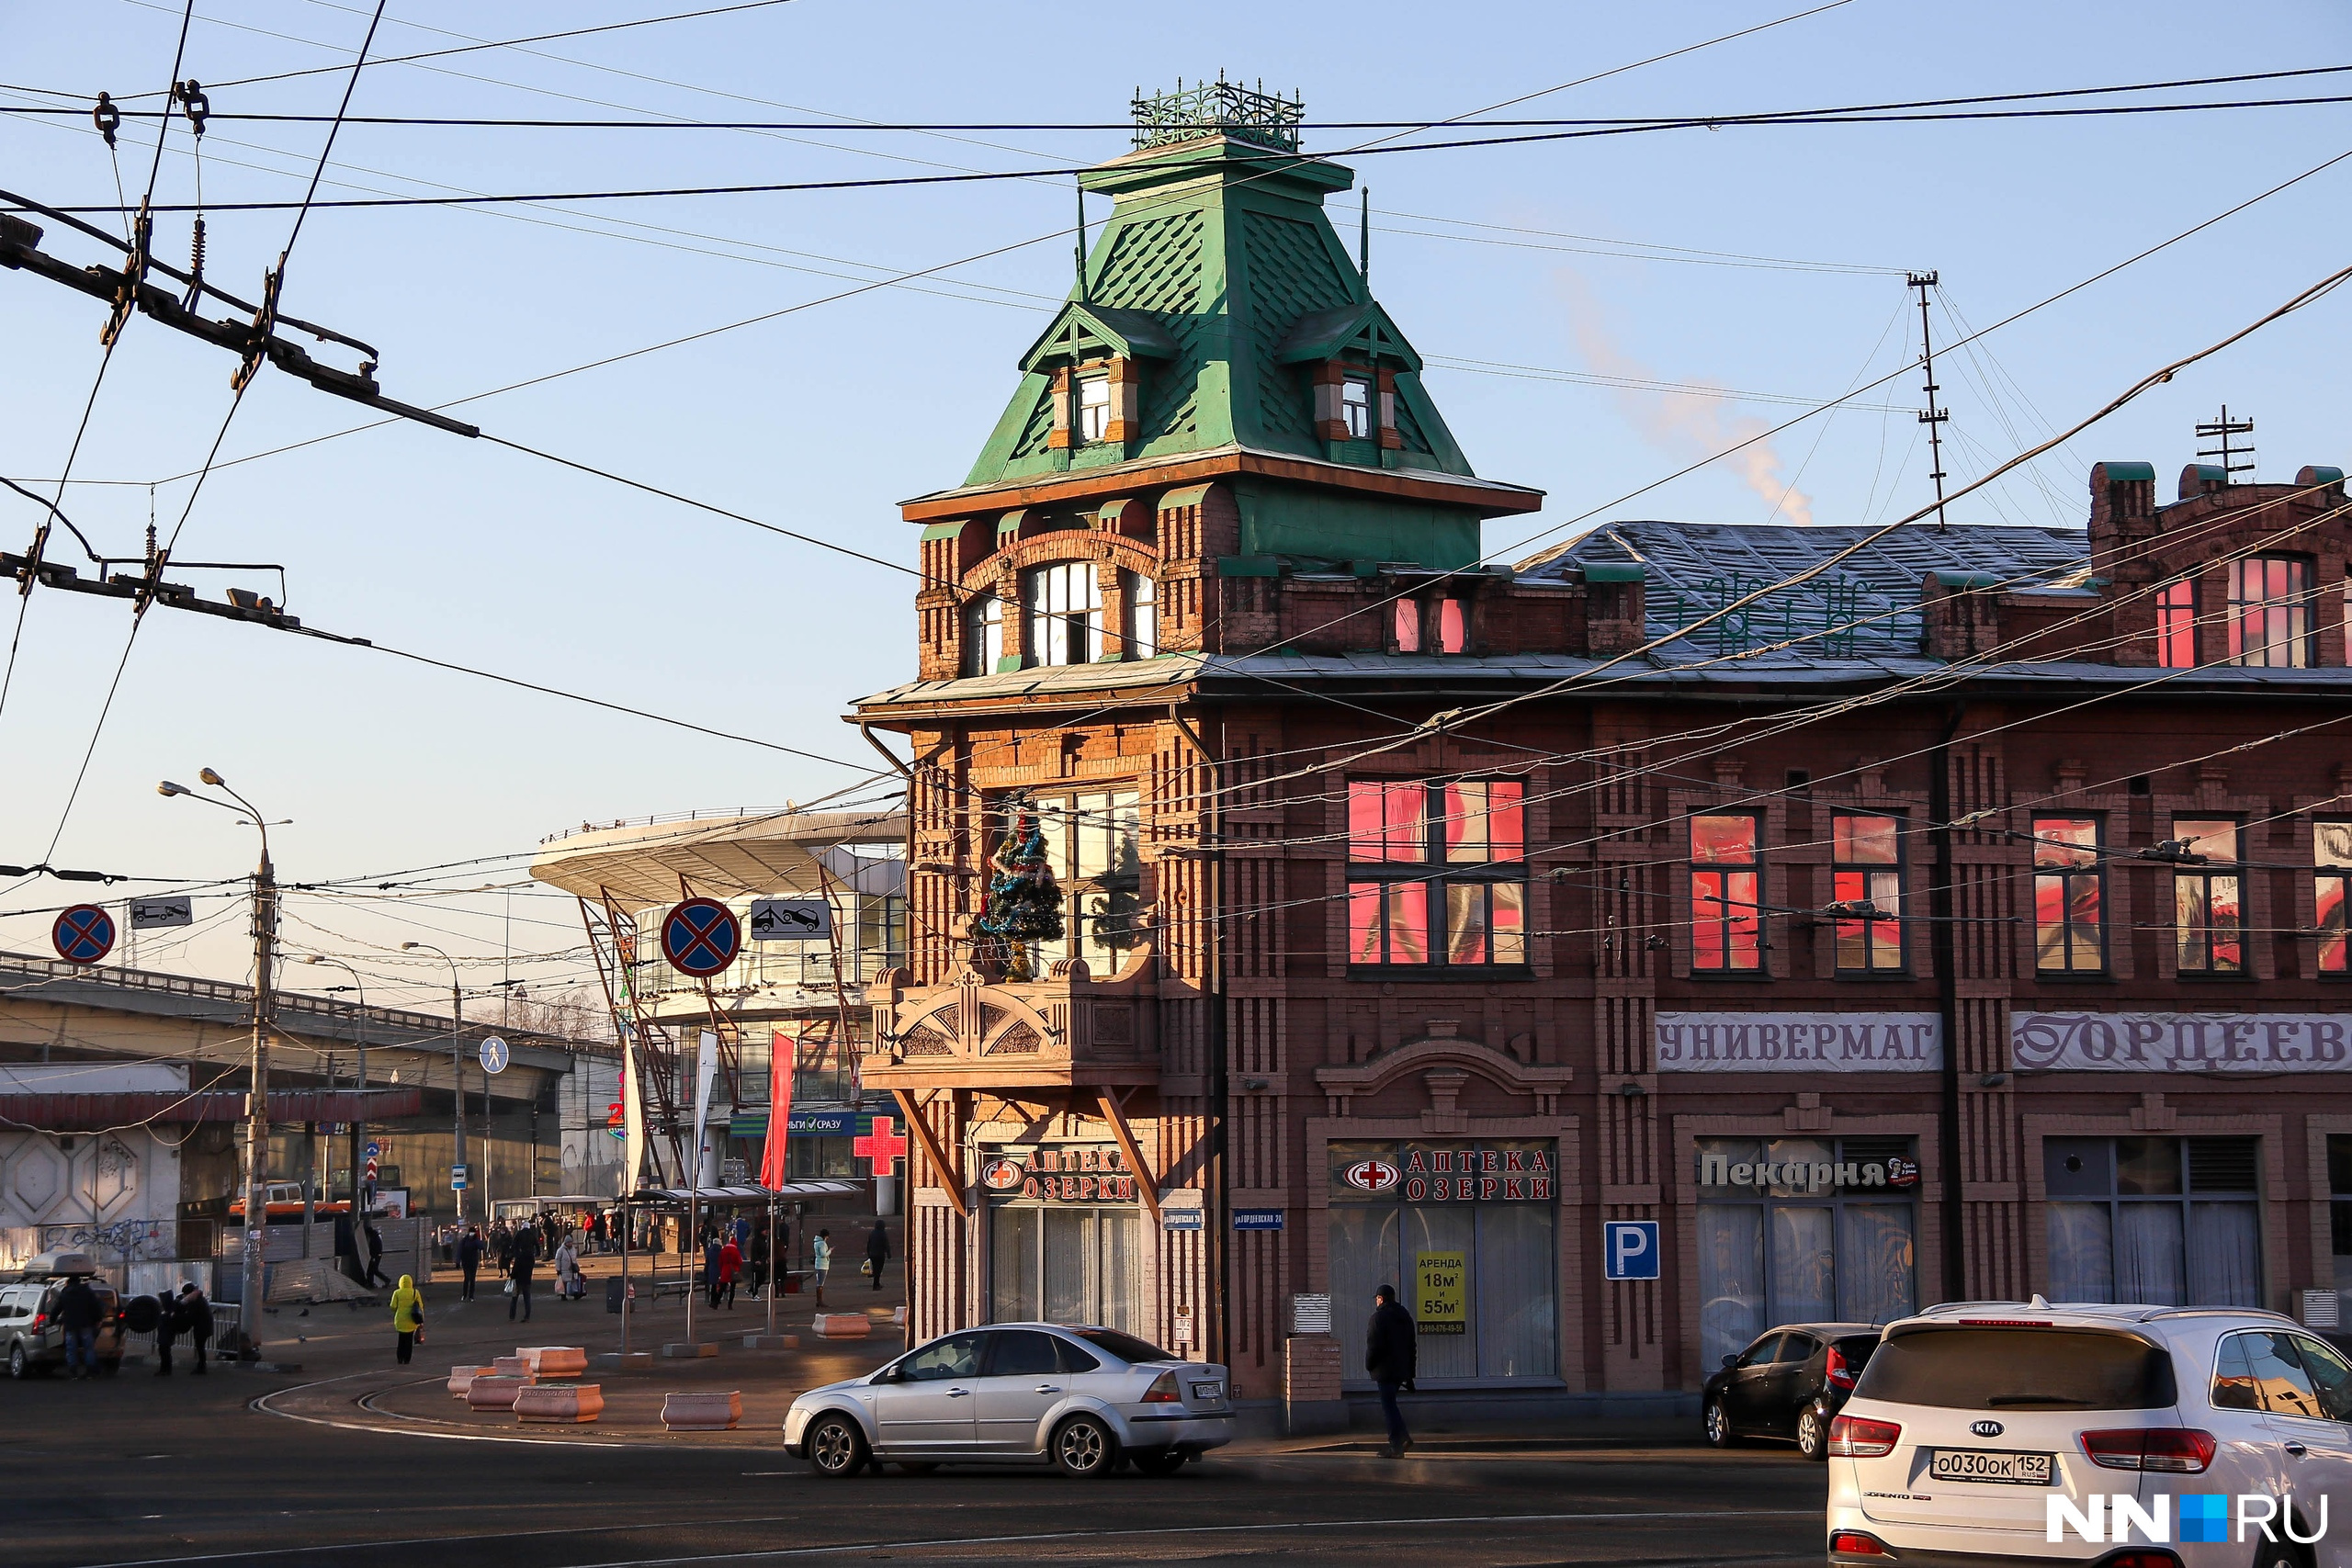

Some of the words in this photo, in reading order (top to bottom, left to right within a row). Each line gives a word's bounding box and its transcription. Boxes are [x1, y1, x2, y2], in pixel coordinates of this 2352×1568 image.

[1656, 1023, 1933, 1061] УНИВЕРМАГ
[2012, 1015, 2352, 1070] ГОРДЕЕВ
[786, 1120, 805, 1129] НЬГИ
[817, 1120, 841, 1129] СРАЗУ
[1024, 1150, 1132, 1172] АПТЕКА
[1408, 1150, 1550, 1172] АПТЕКА
[1701, 1155, 1886, 1193] Пекарня
[1023, 1177, 1132, 1200] ОЗЕРКИ
[1408, 1178, 1550, 1201] ОЗЕРКИ
[1616, 1226, 1647, 1275] P
[1419, 1259, 1462, 1269] АРЕНДА
[1975, 1423, 1999, 1434] KIA
[1938, 1454, 2012, 1475] О030ОК
[2017, 1456, 2045, 1472] 152
